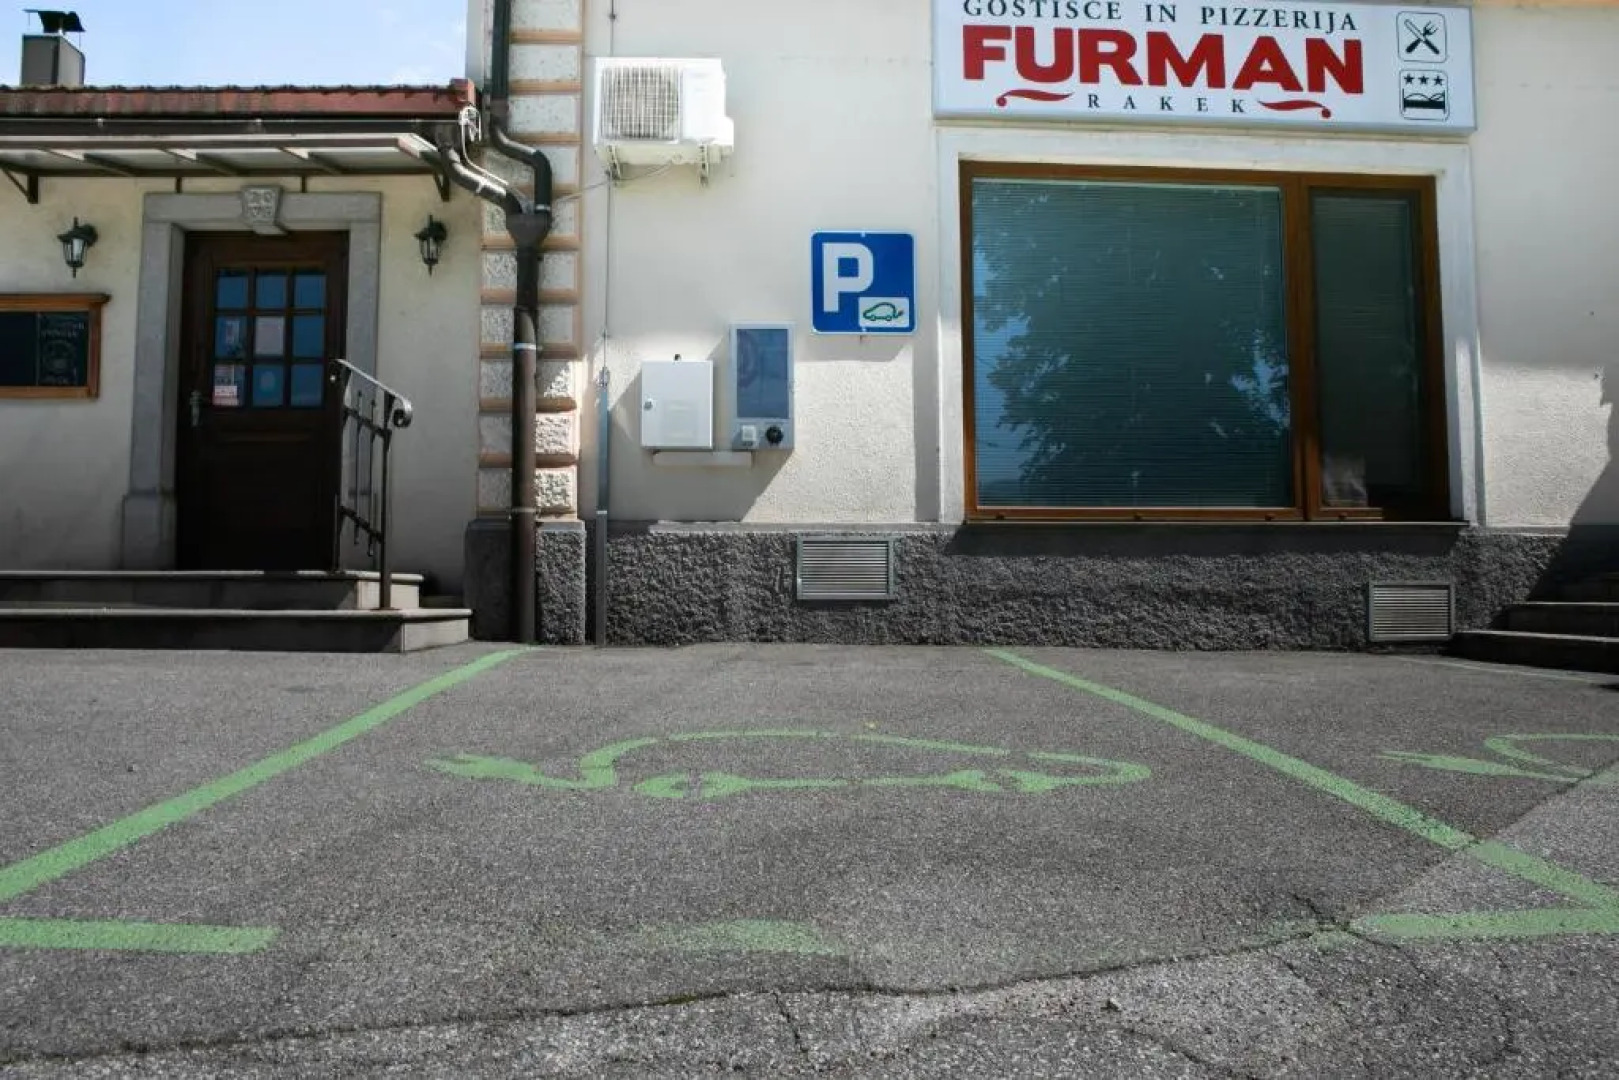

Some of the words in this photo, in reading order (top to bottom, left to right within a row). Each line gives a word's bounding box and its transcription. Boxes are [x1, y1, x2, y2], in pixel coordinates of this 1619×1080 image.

[1145, 4, 1177, 23] IN
[1201, 6, 1357, 34] PIZZERIJA
[962, 24, 1364, 95] FURMAN
[1087, 94, 1245, 113] RAKEK
[823, 242, 874, 312] P
